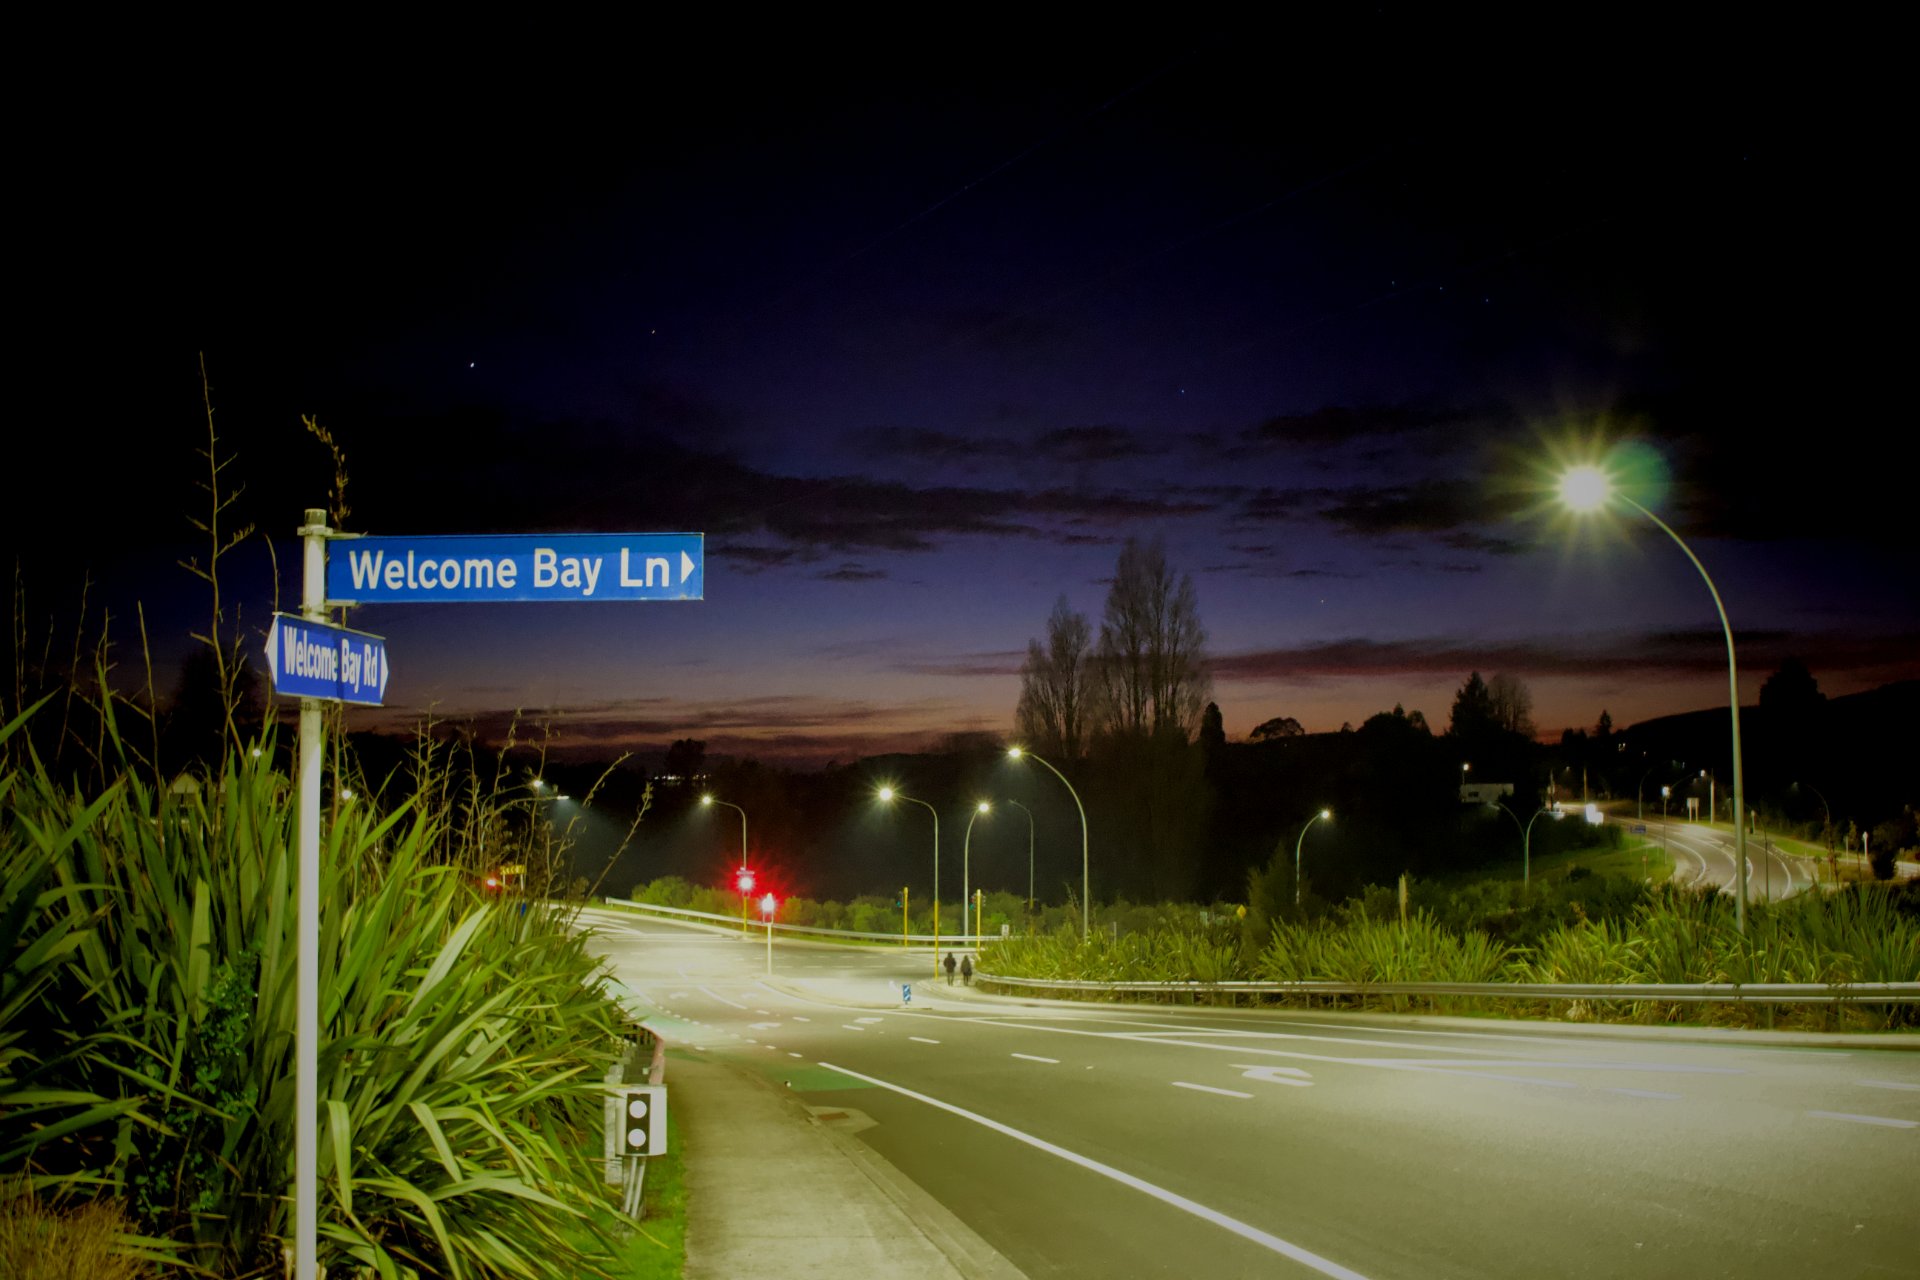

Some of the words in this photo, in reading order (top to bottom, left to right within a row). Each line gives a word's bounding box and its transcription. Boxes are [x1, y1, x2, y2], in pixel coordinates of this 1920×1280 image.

[349, 550, 518, 590] Welcome
[533, 547, 603, 596] Bay
[620, 547, 670, 588] Ln
[283, 625, 338, 682] Welcome
[341, 638, 361, 694] Bay
[363, 643, 378, 688] Rd
